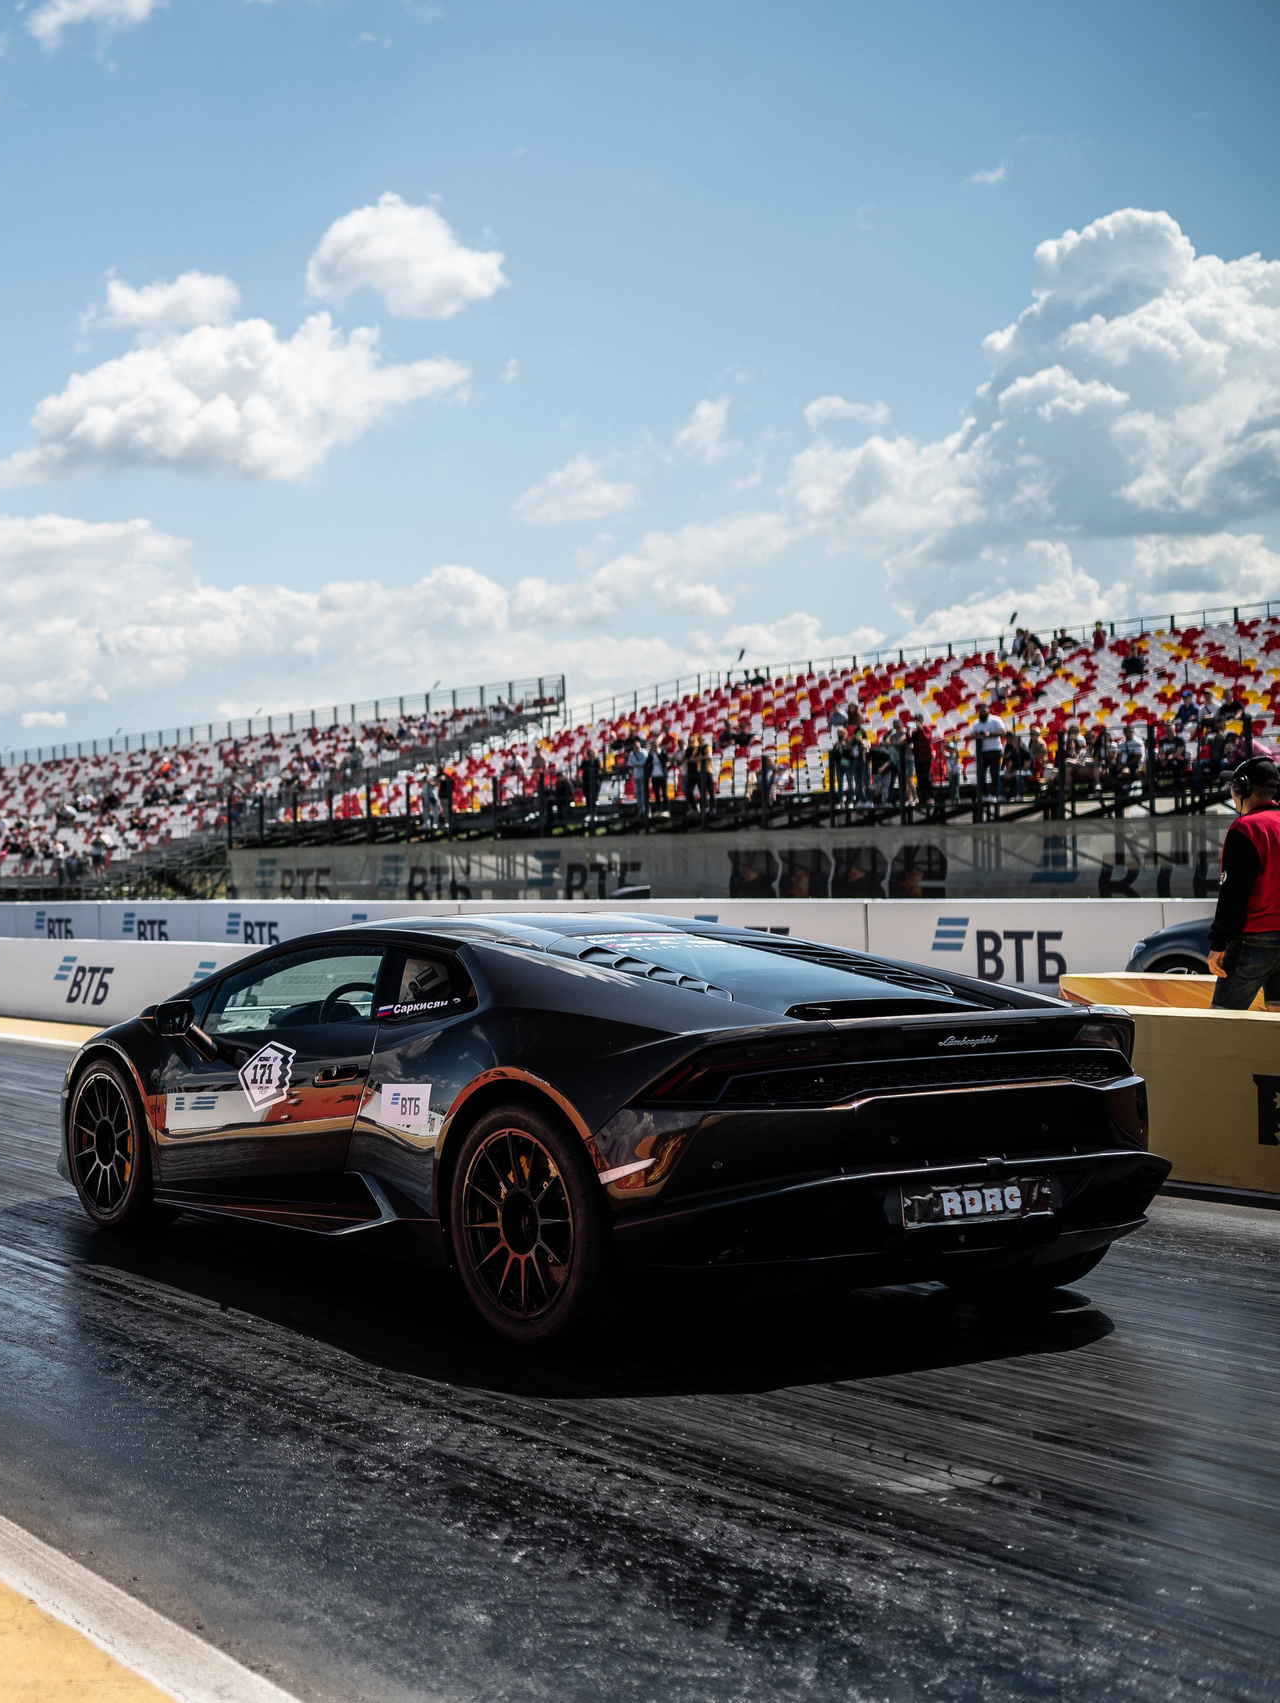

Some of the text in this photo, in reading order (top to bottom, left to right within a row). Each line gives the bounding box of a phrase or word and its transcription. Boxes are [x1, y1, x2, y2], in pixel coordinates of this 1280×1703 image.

[47, 918, 74, 939] ВТБ
[137, 919, 169, 941] ВТБ
[976, 930, 1067, 984] ВТБ
[66, 965, 115, 1006] ВТБ
[393, 1000, 449, 1014] Саркисян
[938, 1035, 998, 1047] Lamborghini
[251, 1064, 274, 1085] 171
[401, 1097, 420, 1116] ВТБ
[941, 1186, 1022, 1216] RDRC
